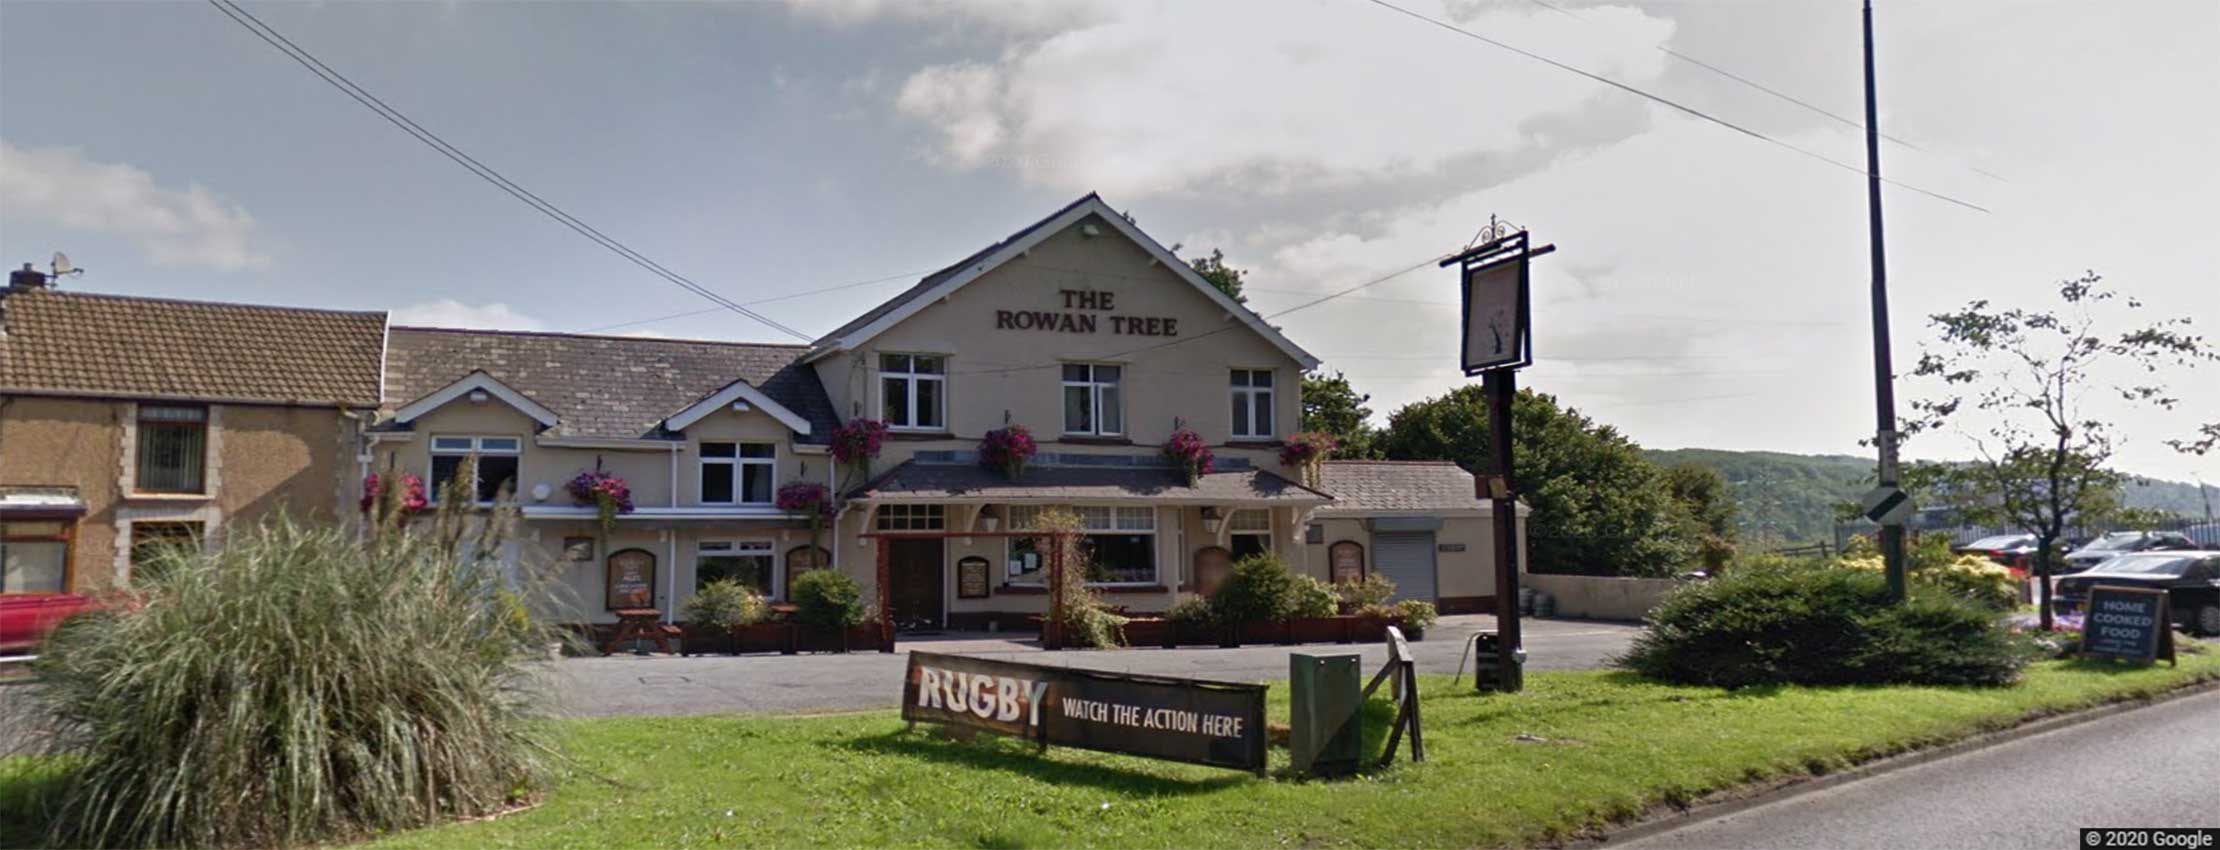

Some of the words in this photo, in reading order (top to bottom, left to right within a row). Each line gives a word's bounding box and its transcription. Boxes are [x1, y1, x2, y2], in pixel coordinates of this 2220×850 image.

[1060, 289, 1115, 311] THE
[996, 310, 1097, 334] ROWAN
[1109, 315, 1178, 337] TREE
[2103, 601, 2145, 613] HOME
[2093, 613, 2152, 626] COOKED
[2101, 627, 2141, 639] FOOD
[918, 666, 1048, 726] RUGBY
[1062, 697, 1108, 723] WATCH
[1112, 705, 1141, 728] THE
[1143, 708, 1198, 733] ACTION
[1202, 714, 1243, 738] HERE
